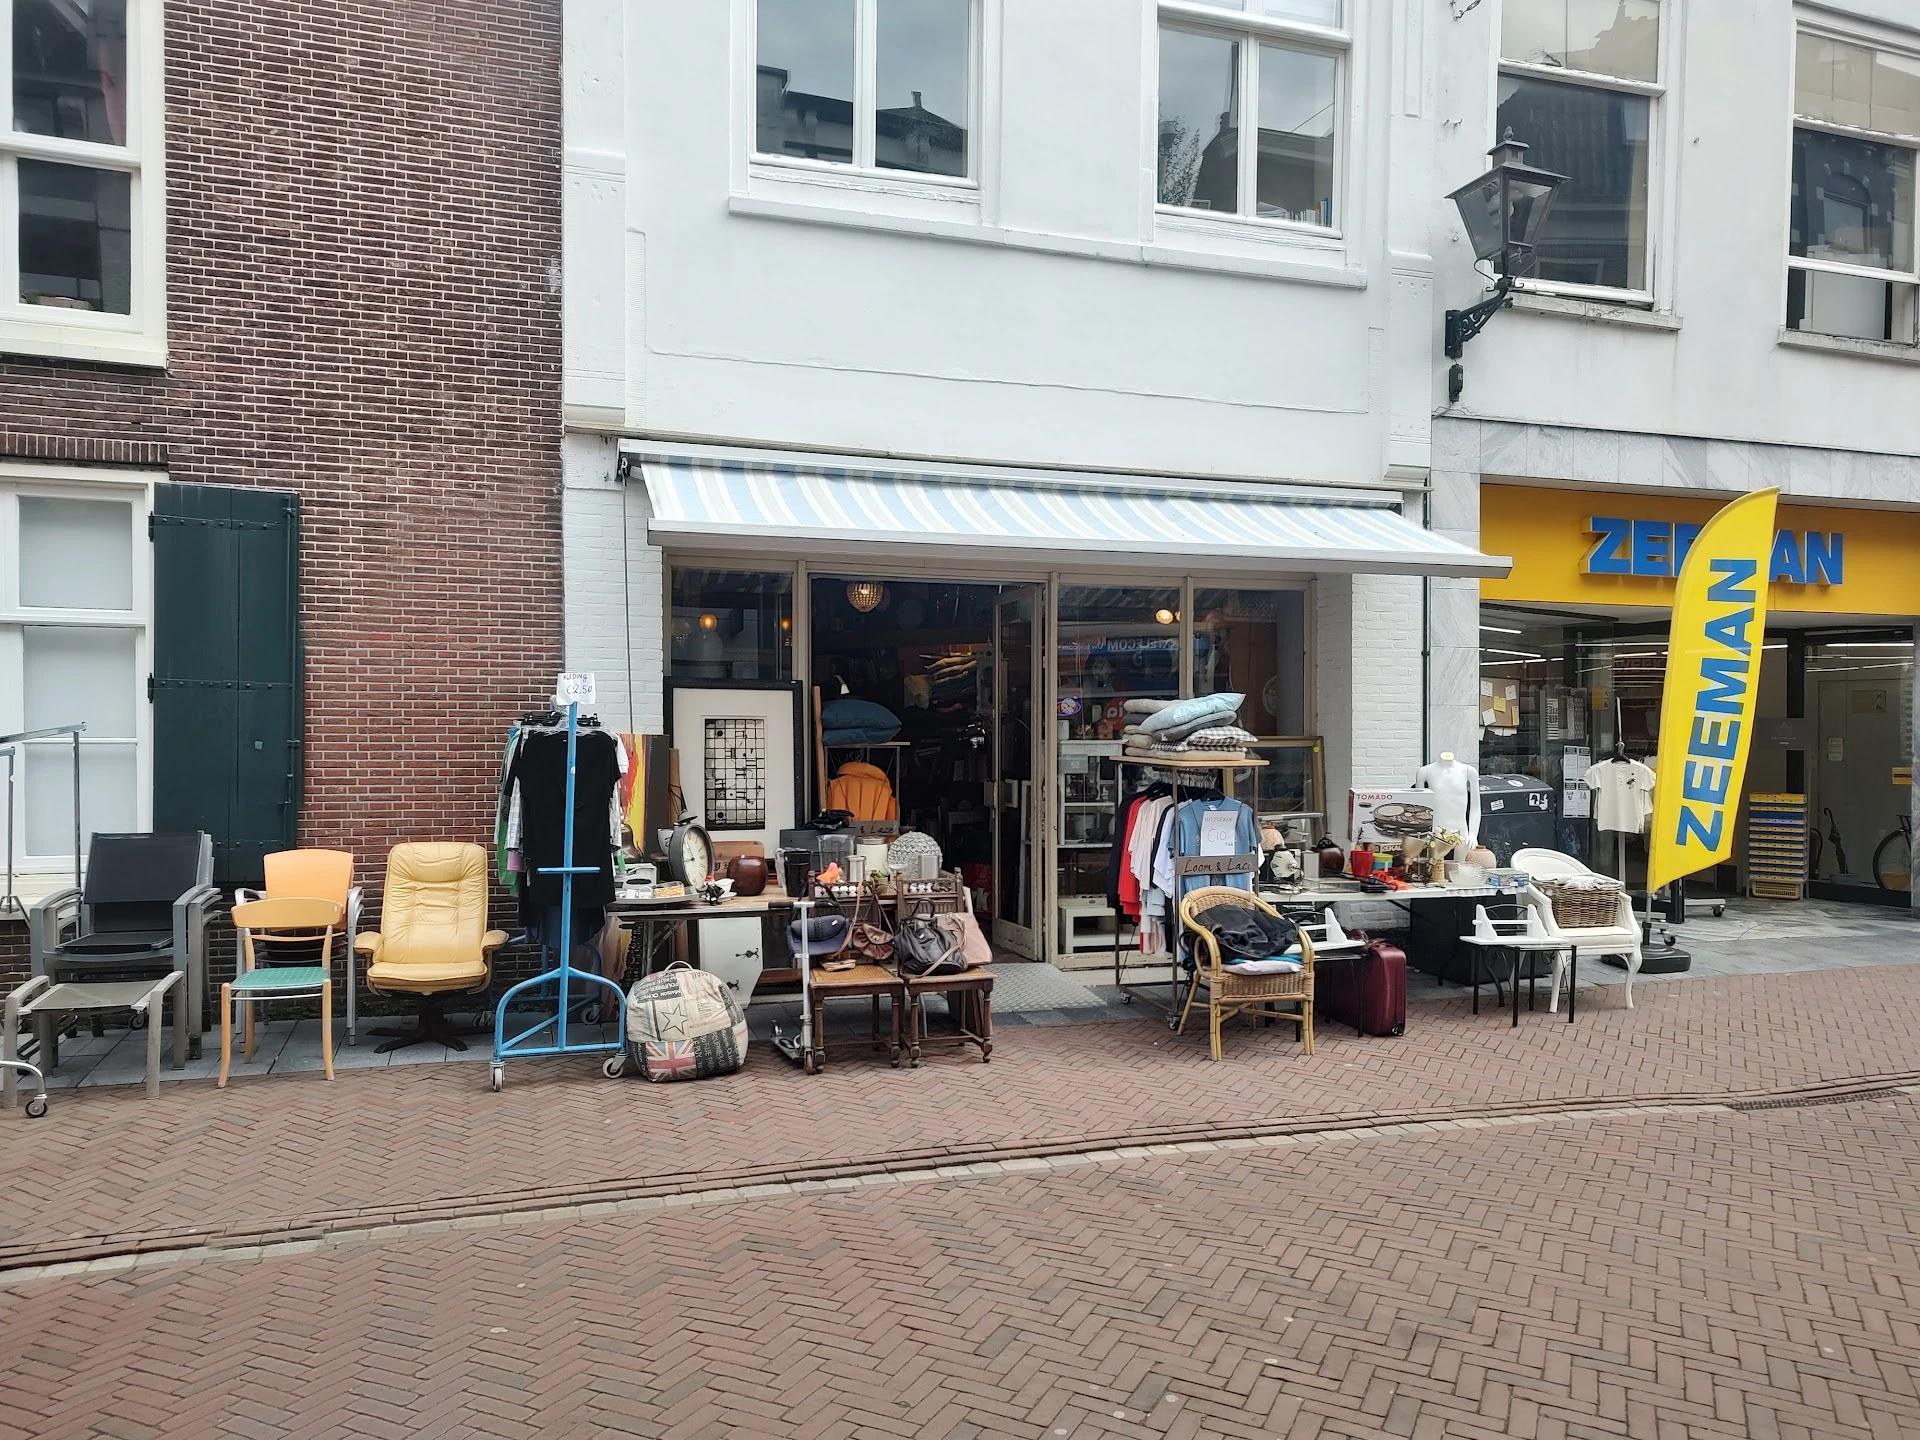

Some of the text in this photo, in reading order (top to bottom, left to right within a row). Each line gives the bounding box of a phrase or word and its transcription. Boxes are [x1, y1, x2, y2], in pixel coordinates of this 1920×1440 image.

[1582, 515, 1844, 585] ZEAN
[1675, 558, 1758, 852] ZEEMAN
[1070, 761, 1080, 769] 52
[1184, 859, 1212, 873] Loom
[1216, 861, 1223, 873] &
